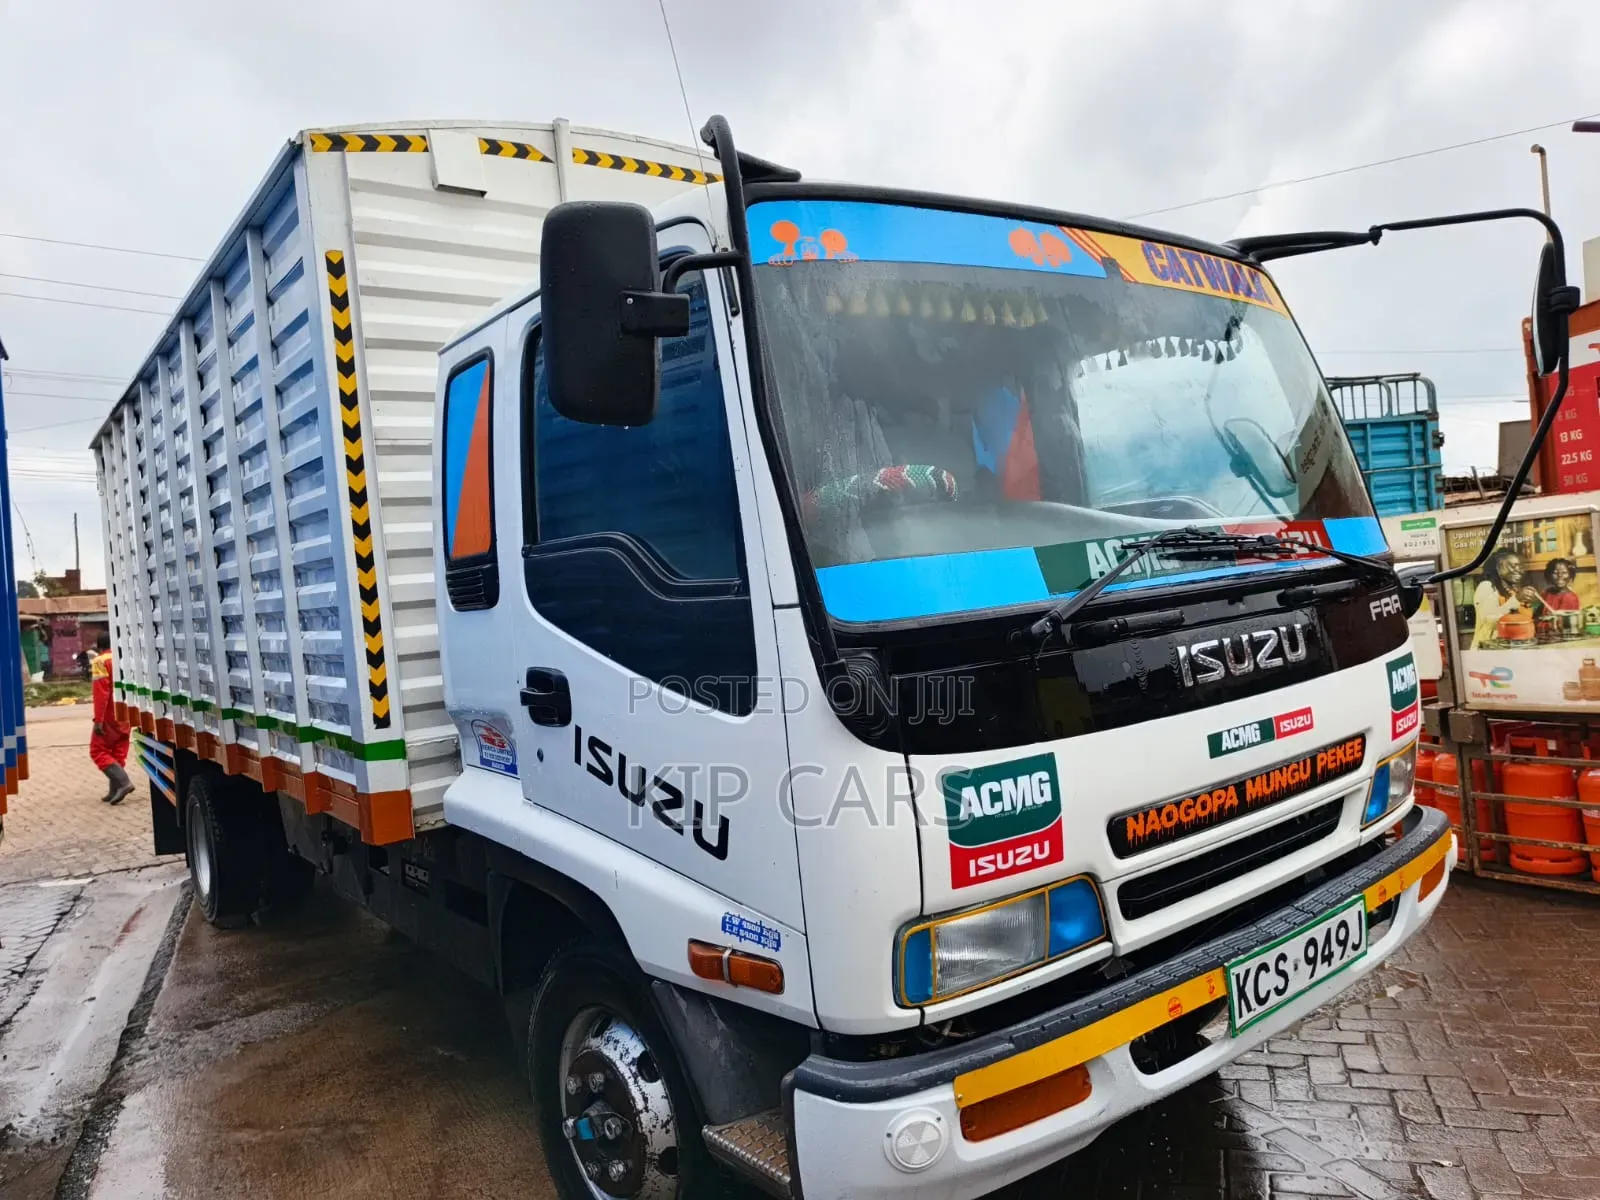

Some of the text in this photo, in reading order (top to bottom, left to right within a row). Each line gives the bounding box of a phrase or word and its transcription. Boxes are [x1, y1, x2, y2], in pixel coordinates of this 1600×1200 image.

[1141, 240, 1273, 305] CATWALK
[1565, 408, 1577, 420] KG
[1559, 429, 1583, 443] 13 KG
[1561, 450, 1593, 465] 22.5 KG
[1576, 472, 1588, 484] KG
[1177, 624, 1306, 688] ISUZU
[1392, 663, 1416, 695] ACMG
[1221, 713, 1311, 751] ACMG ISUZU
[1396, 712, 1417, 734] ISUZU
[574, 724, 730, 861] ISUZU
[960, 771, 1053, 821] ACMG
[1126, 736, 1362, 844] NAOGOPA MUNGU PEKEE
[969, 840, 1051, 878] ISUZU
[1235, 910, 1363, 1019] KCS 949J
